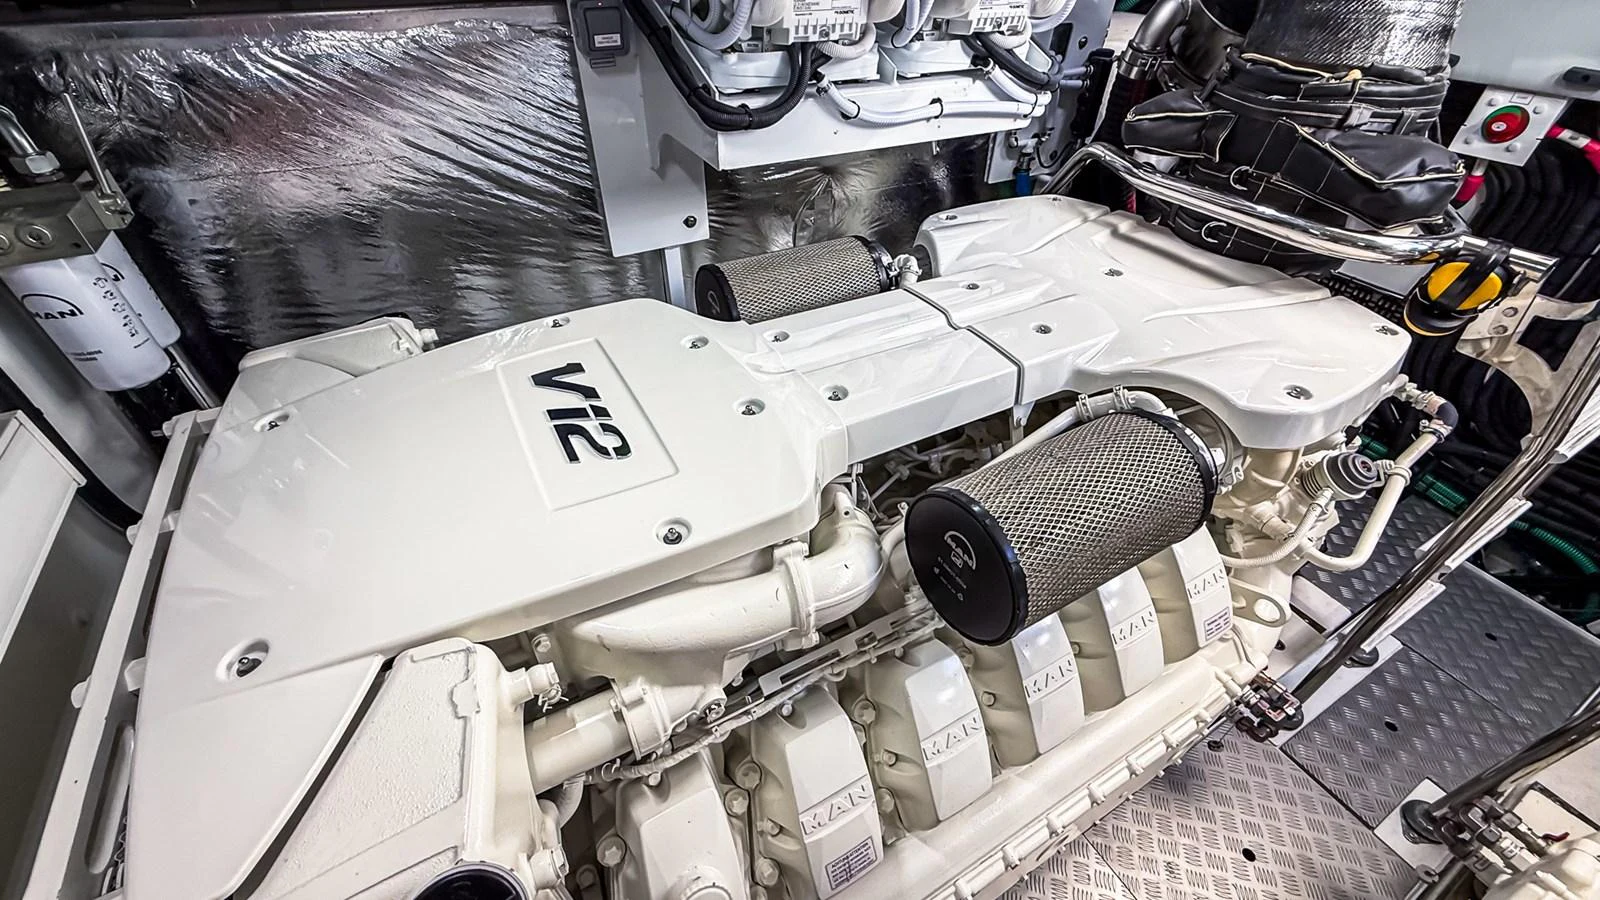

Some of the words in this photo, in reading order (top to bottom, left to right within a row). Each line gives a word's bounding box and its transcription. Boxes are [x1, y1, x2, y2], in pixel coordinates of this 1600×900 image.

[1187, 568, 1225, 599] MAN
[1112, 610, 1155, 645] MAN
[1024, 658, 1075, 699] MAN
[923, 715, 981, 761] MAN
[801, 784, 872, 836] MAN
